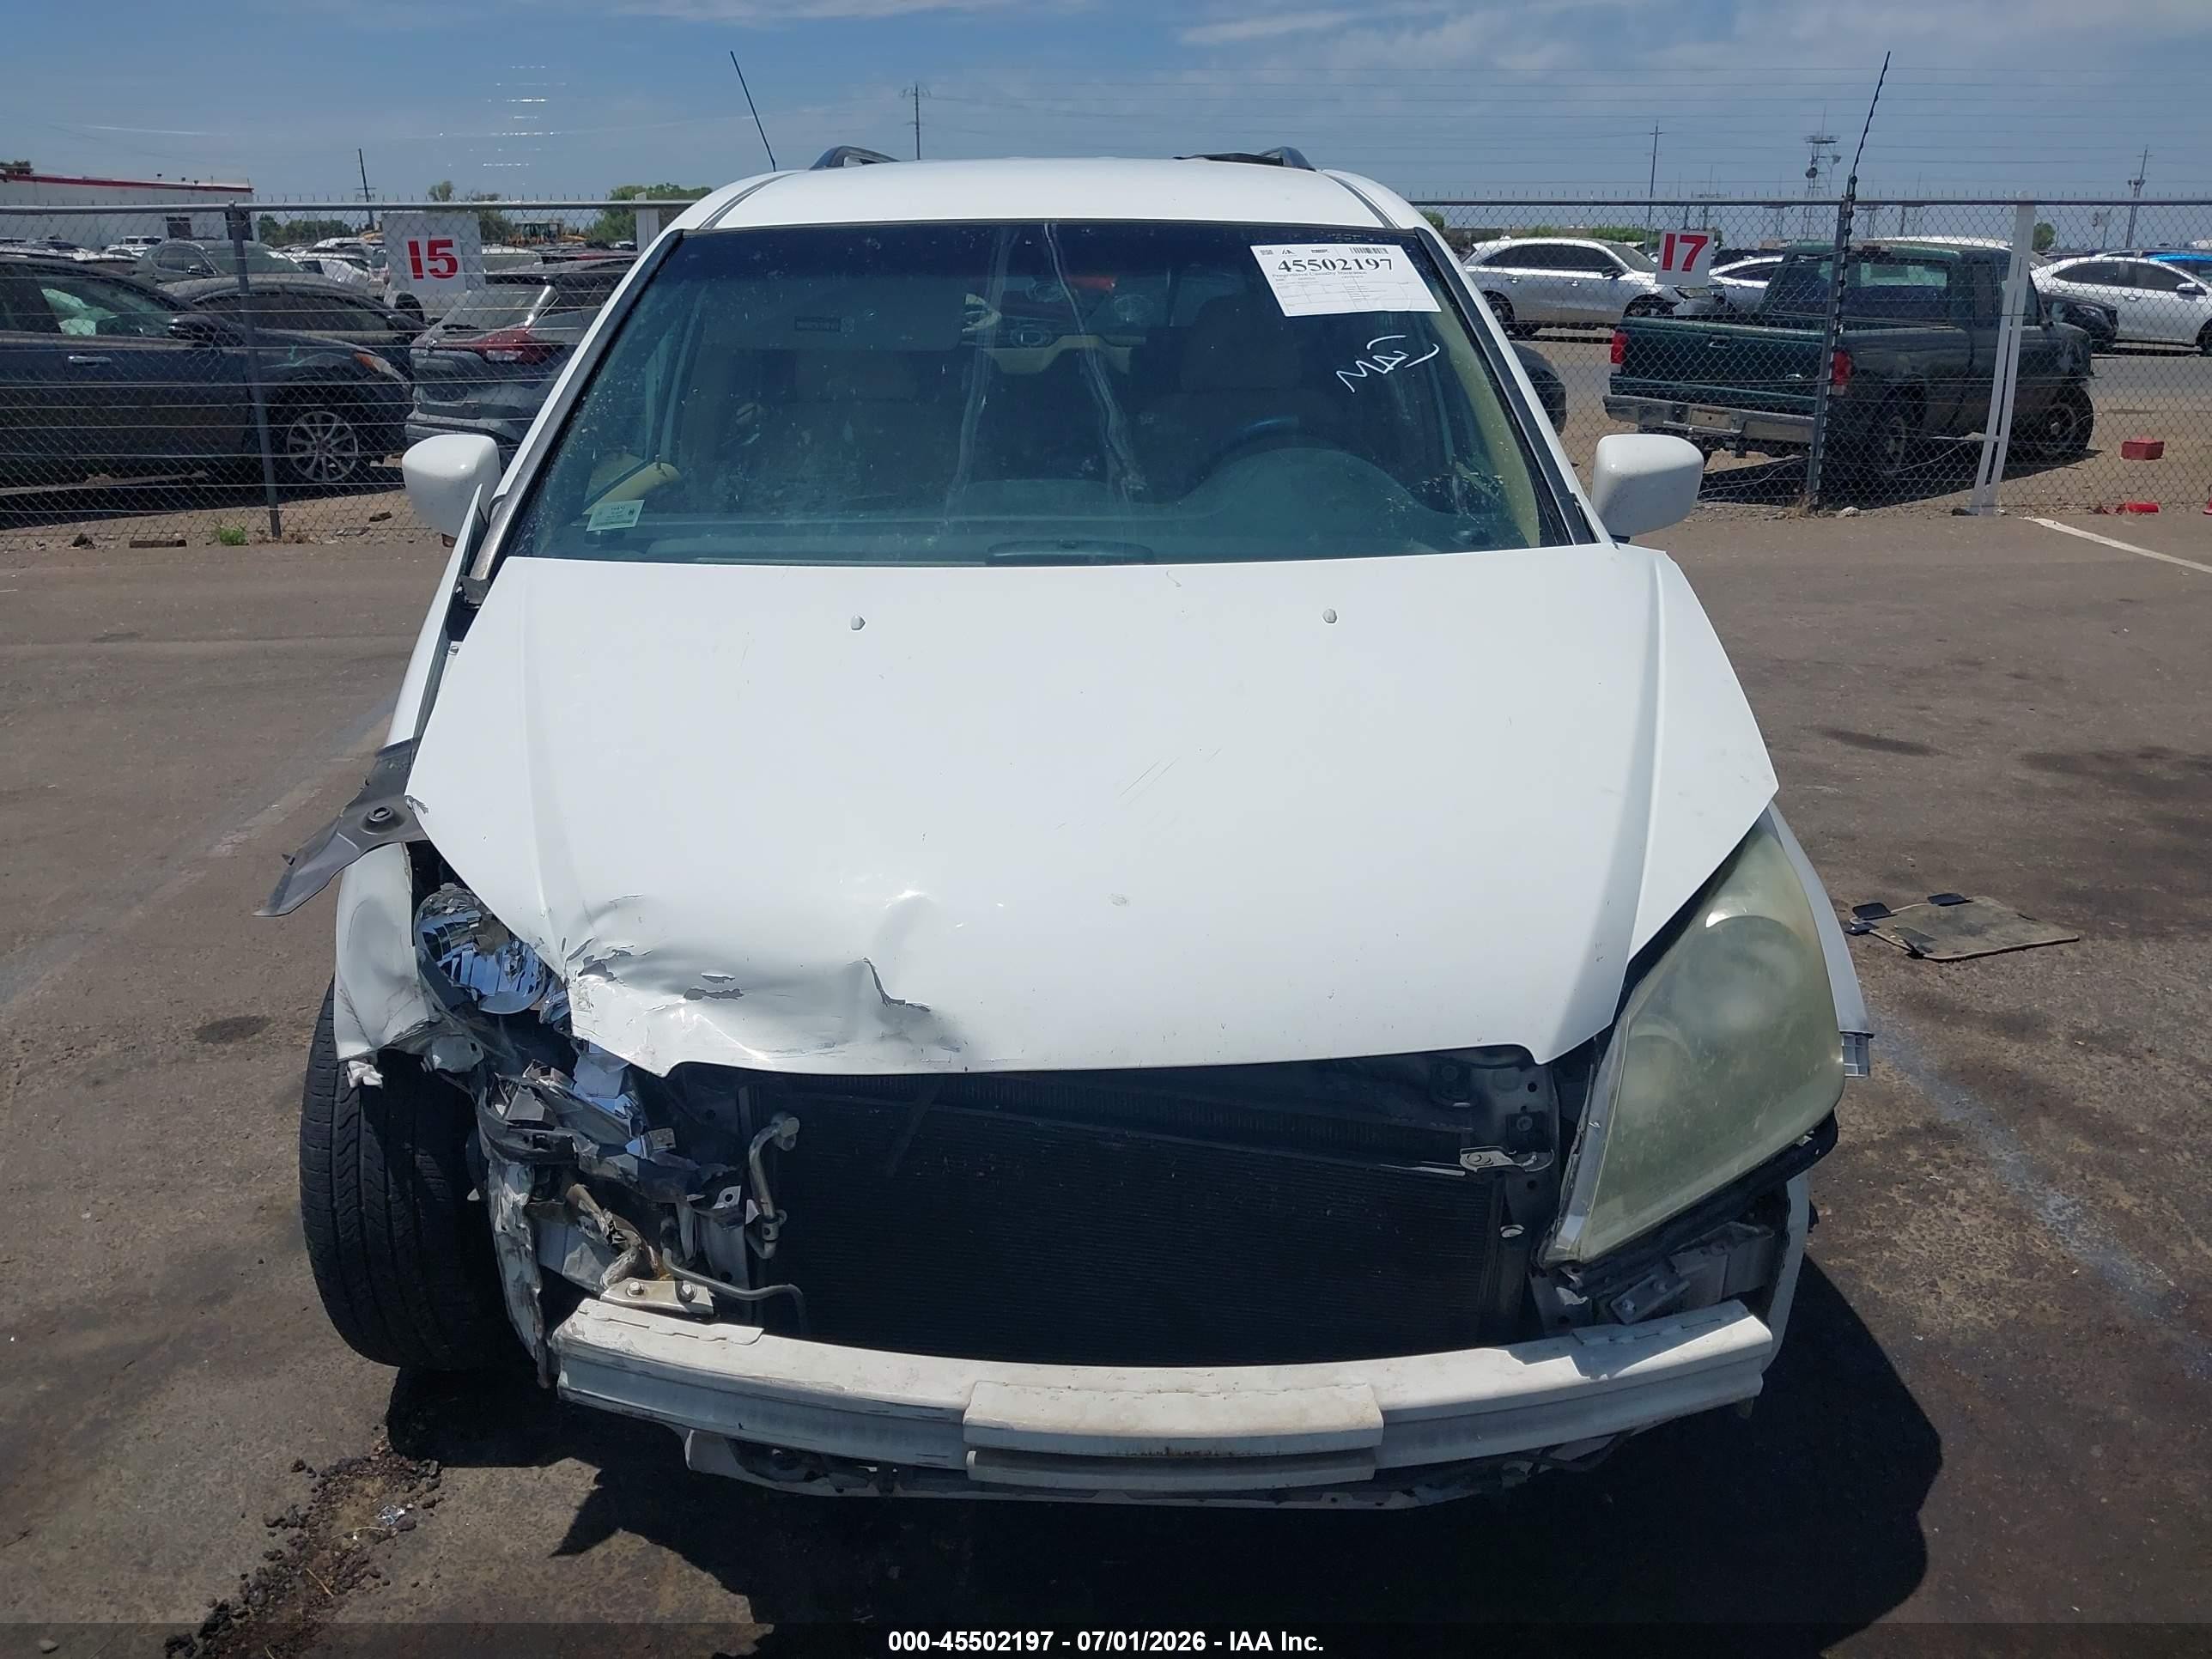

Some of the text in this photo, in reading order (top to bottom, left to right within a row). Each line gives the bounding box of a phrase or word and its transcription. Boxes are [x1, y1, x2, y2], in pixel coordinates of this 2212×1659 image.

[408, 240, 459, 280] 15
[1278, 258, 1392, 272] 45502197
[1662, 233, 1709, 272] 17
